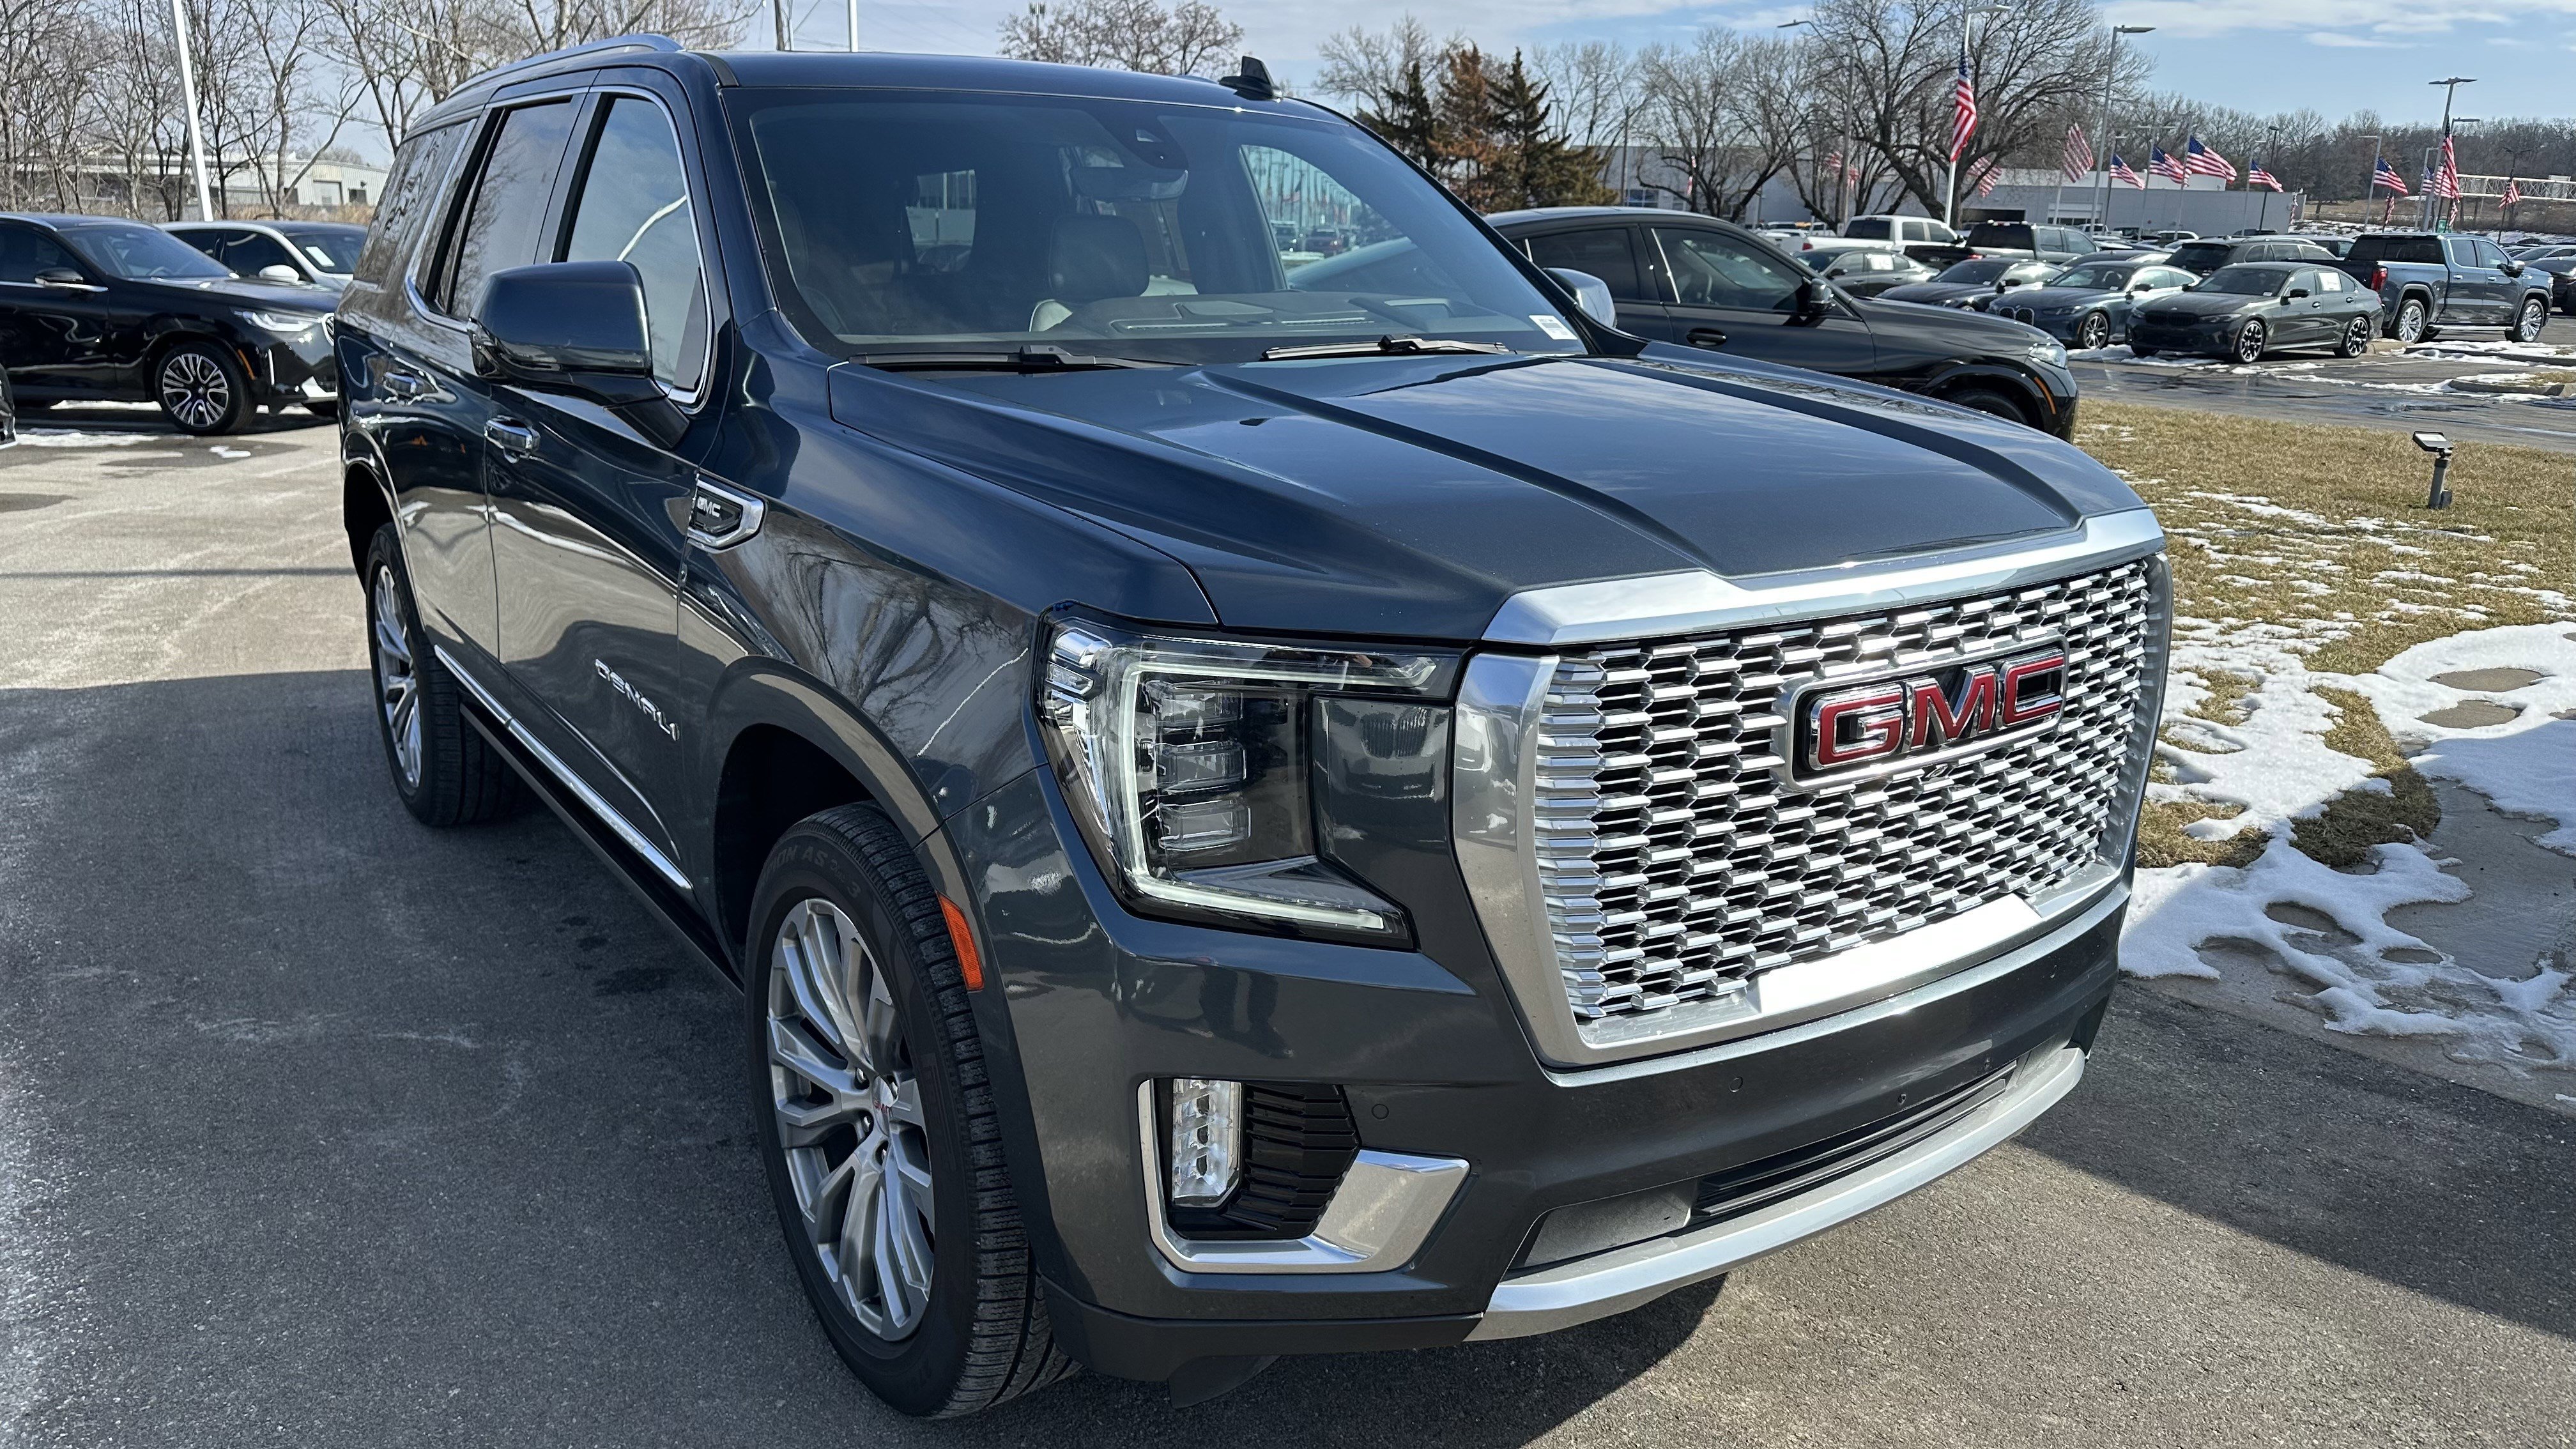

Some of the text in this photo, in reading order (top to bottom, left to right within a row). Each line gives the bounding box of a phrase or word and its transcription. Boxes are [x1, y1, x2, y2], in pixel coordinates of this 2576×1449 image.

[698, 496, 721, 518] GMC
[595, 658, 680, 741] DENALI
[1809, 648, 2066, 770] GMC
[802, 845, 828, 866] AS
[847, 882, 861, 898] 3
